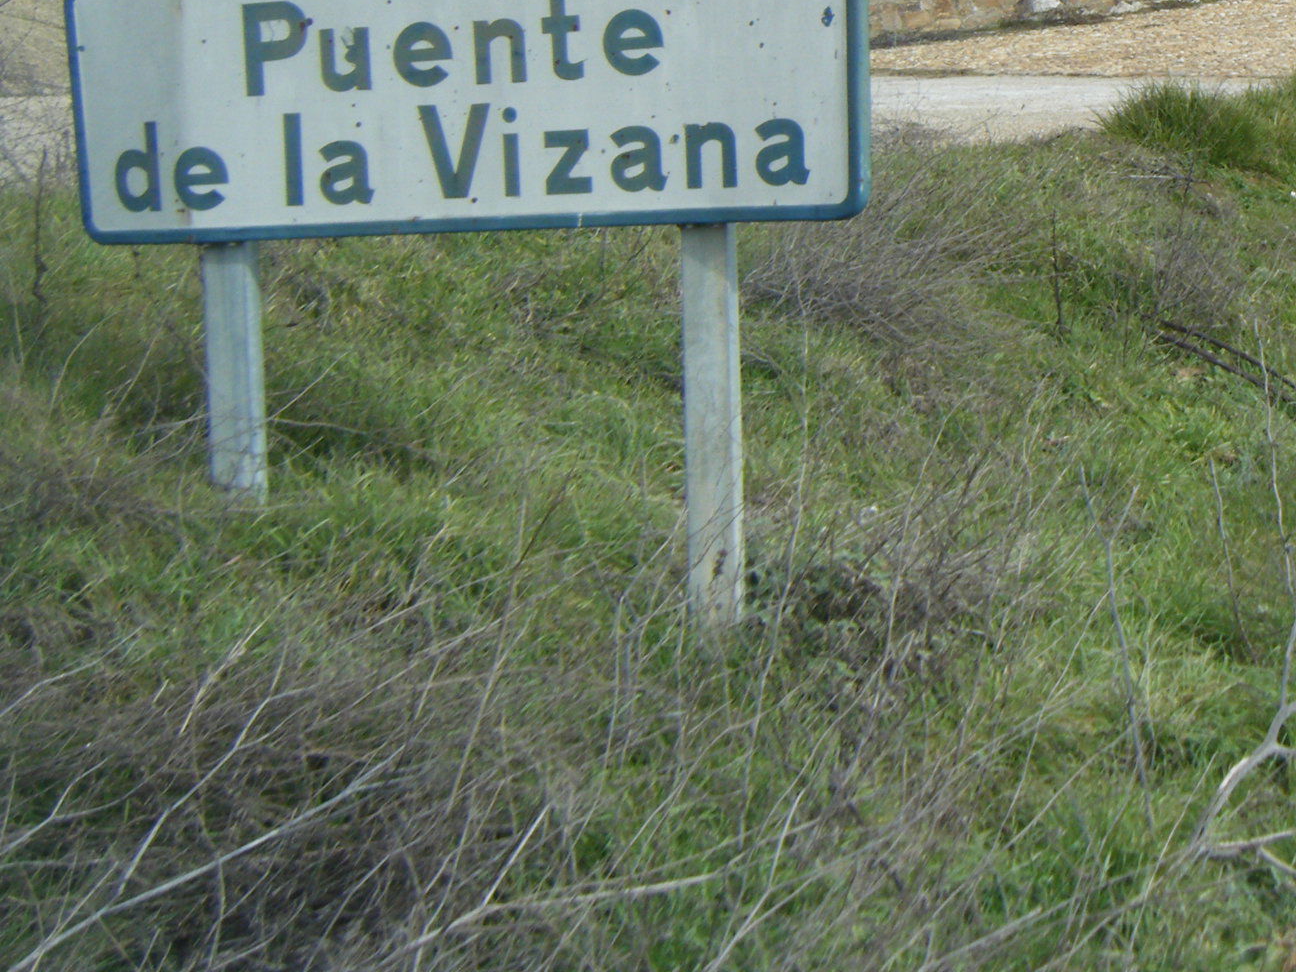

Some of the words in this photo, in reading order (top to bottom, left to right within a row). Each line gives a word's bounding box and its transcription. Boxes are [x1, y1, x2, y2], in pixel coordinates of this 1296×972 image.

[114, 121, 229, 212] de
[283, 112, 375, 207] la
[418, 102, 810, 200] Vizana
